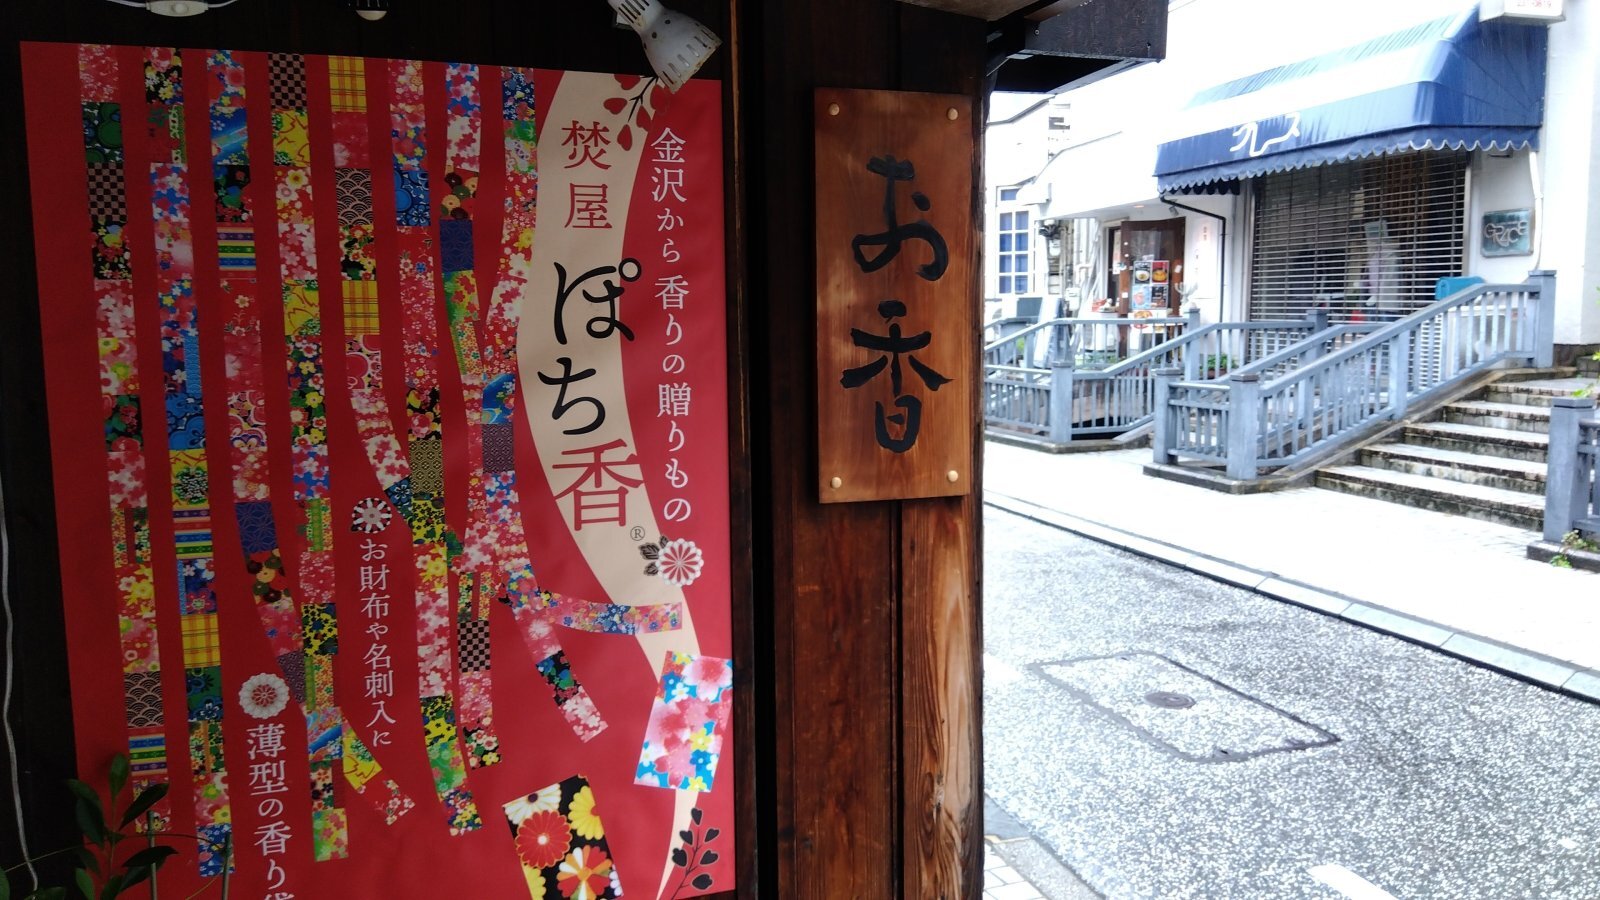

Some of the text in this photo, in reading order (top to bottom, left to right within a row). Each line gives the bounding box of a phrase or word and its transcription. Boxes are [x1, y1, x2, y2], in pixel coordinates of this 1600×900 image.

[537, 120, 645, 532] 焚屋 ぽち香
[650, 127, 692, 522] 金沢から香りの贈りもの
[840, 154, 955, 454] お香
[359, 538, 396, 747] お財布や名刺入に
[246, 723, 295, 900] 薄型の香り
